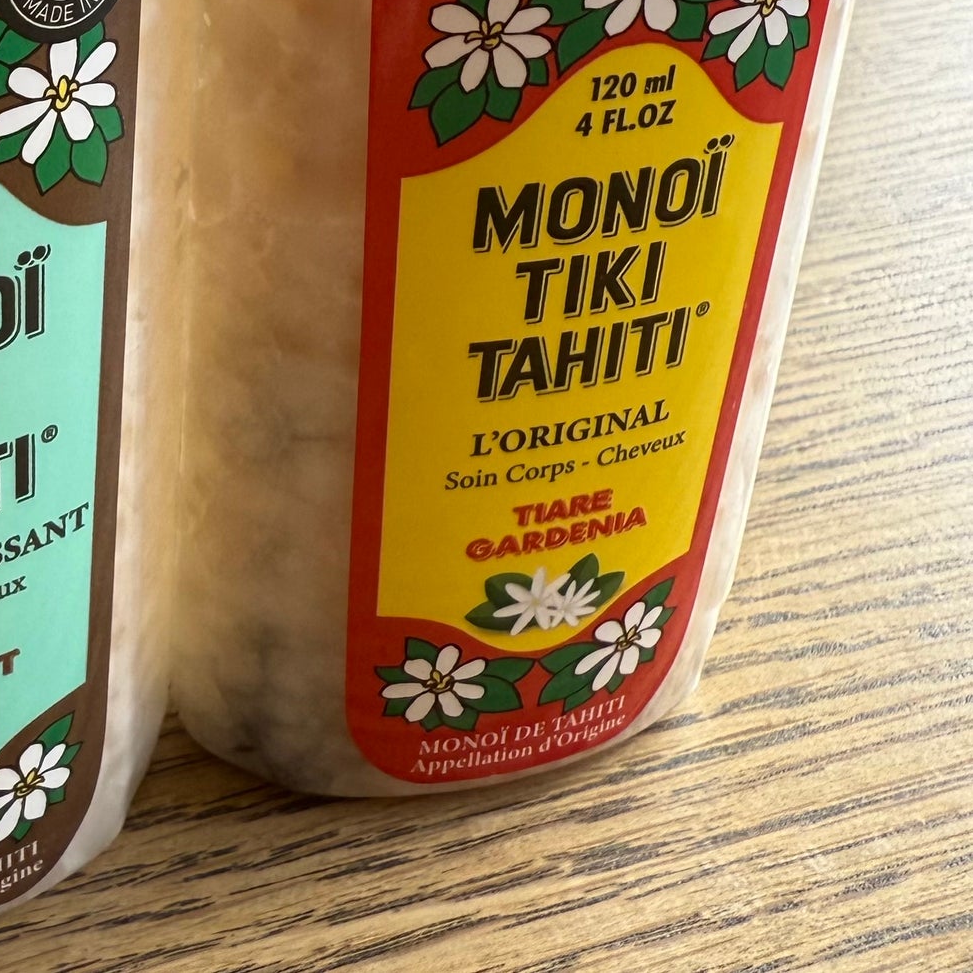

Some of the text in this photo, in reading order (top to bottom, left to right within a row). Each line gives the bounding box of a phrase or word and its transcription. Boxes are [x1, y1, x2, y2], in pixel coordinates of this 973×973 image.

[590, 64, 677, 102] 120 ml
[575, 99, 677, 137] 4 FL.OZ
[472, 133, 735, 254] MONOÏ
[515, 240, 667, 325] TIKI
[470, 399, 670, 457] L'ORIGINAL
[444, 469, 497, 491] Soin
[506, 458, 575, 483] Corps
[597, 430, 687, 467] Cheveux
[465, 506, 648, 562] GARDENIA
[513, 488, 614, 527] TIARE
[418, 695, 626, 756] MONOÏ DE TAHITI
[410, 744, 533, 776] Appellation
